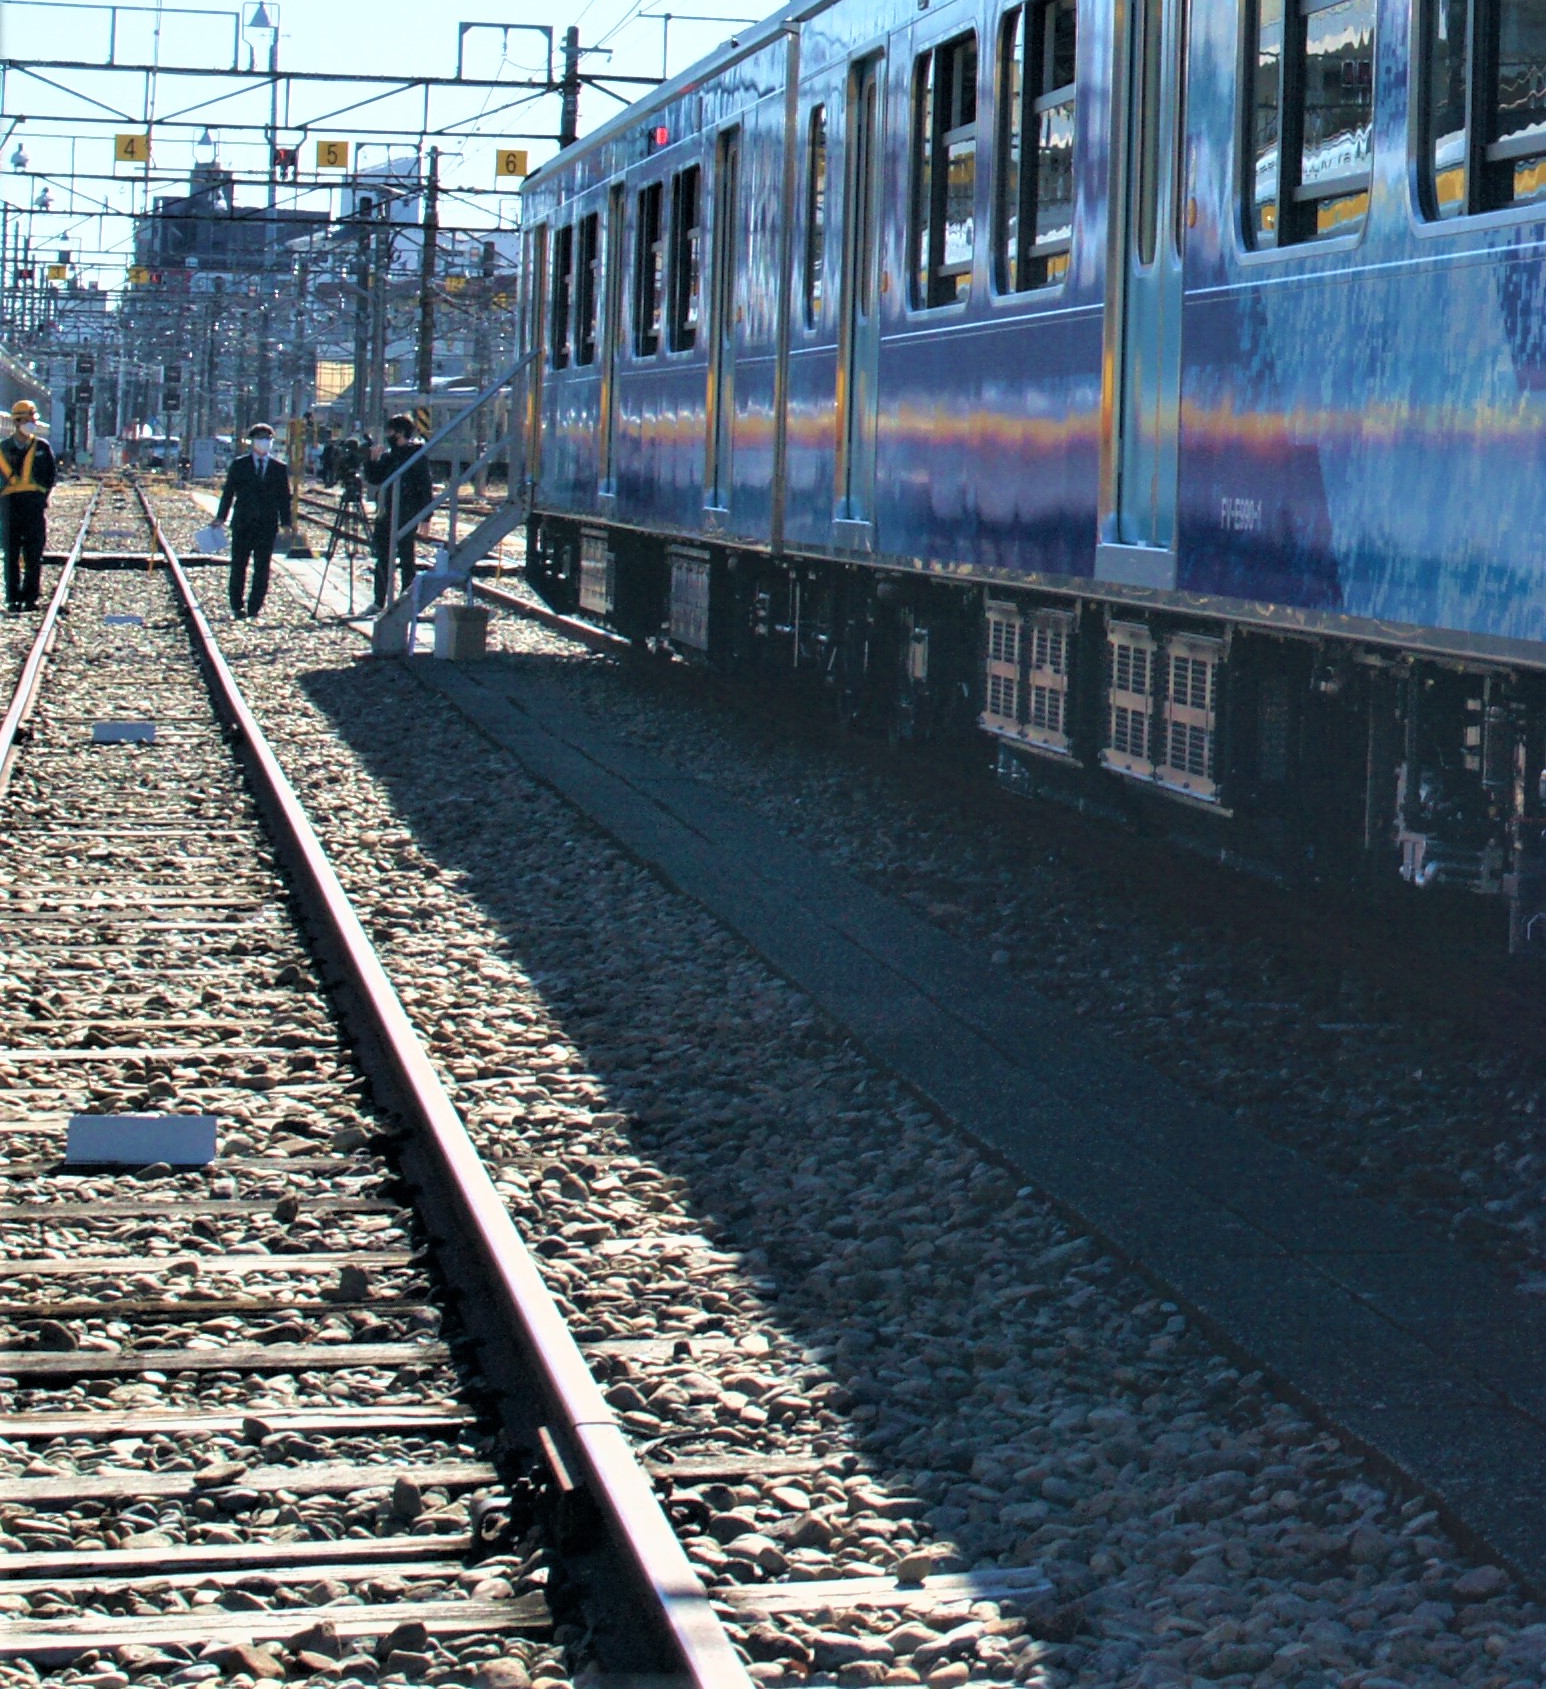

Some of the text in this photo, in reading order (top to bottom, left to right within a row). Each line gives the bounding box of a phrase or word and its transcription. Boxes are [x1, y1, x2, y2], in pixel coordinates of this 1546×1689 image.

[123, 138, 135, 159] 4
[326, 144, 338, 165] 5
[505, 152, 517, 174] 6
